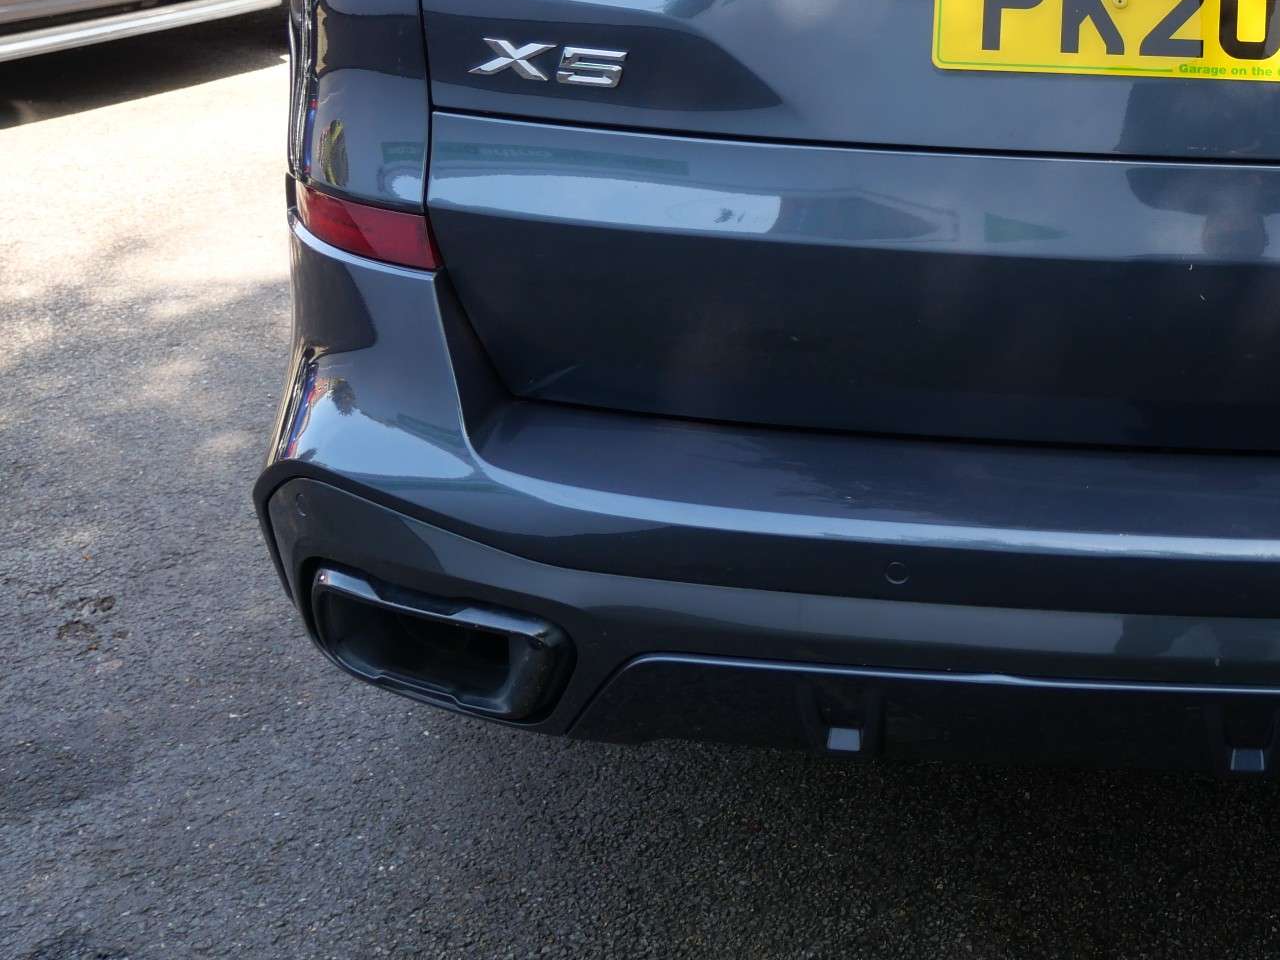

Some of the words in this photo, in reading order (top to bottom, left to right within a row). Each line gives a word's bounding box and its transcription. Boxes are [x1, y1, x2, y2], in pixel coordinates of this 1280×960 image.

[467, 37, 629, 89] X5
[1178, 63, 1227, 76] Garage
[1231, 67, 1247, 76] on
[1251, 66, 1273, 77] the
